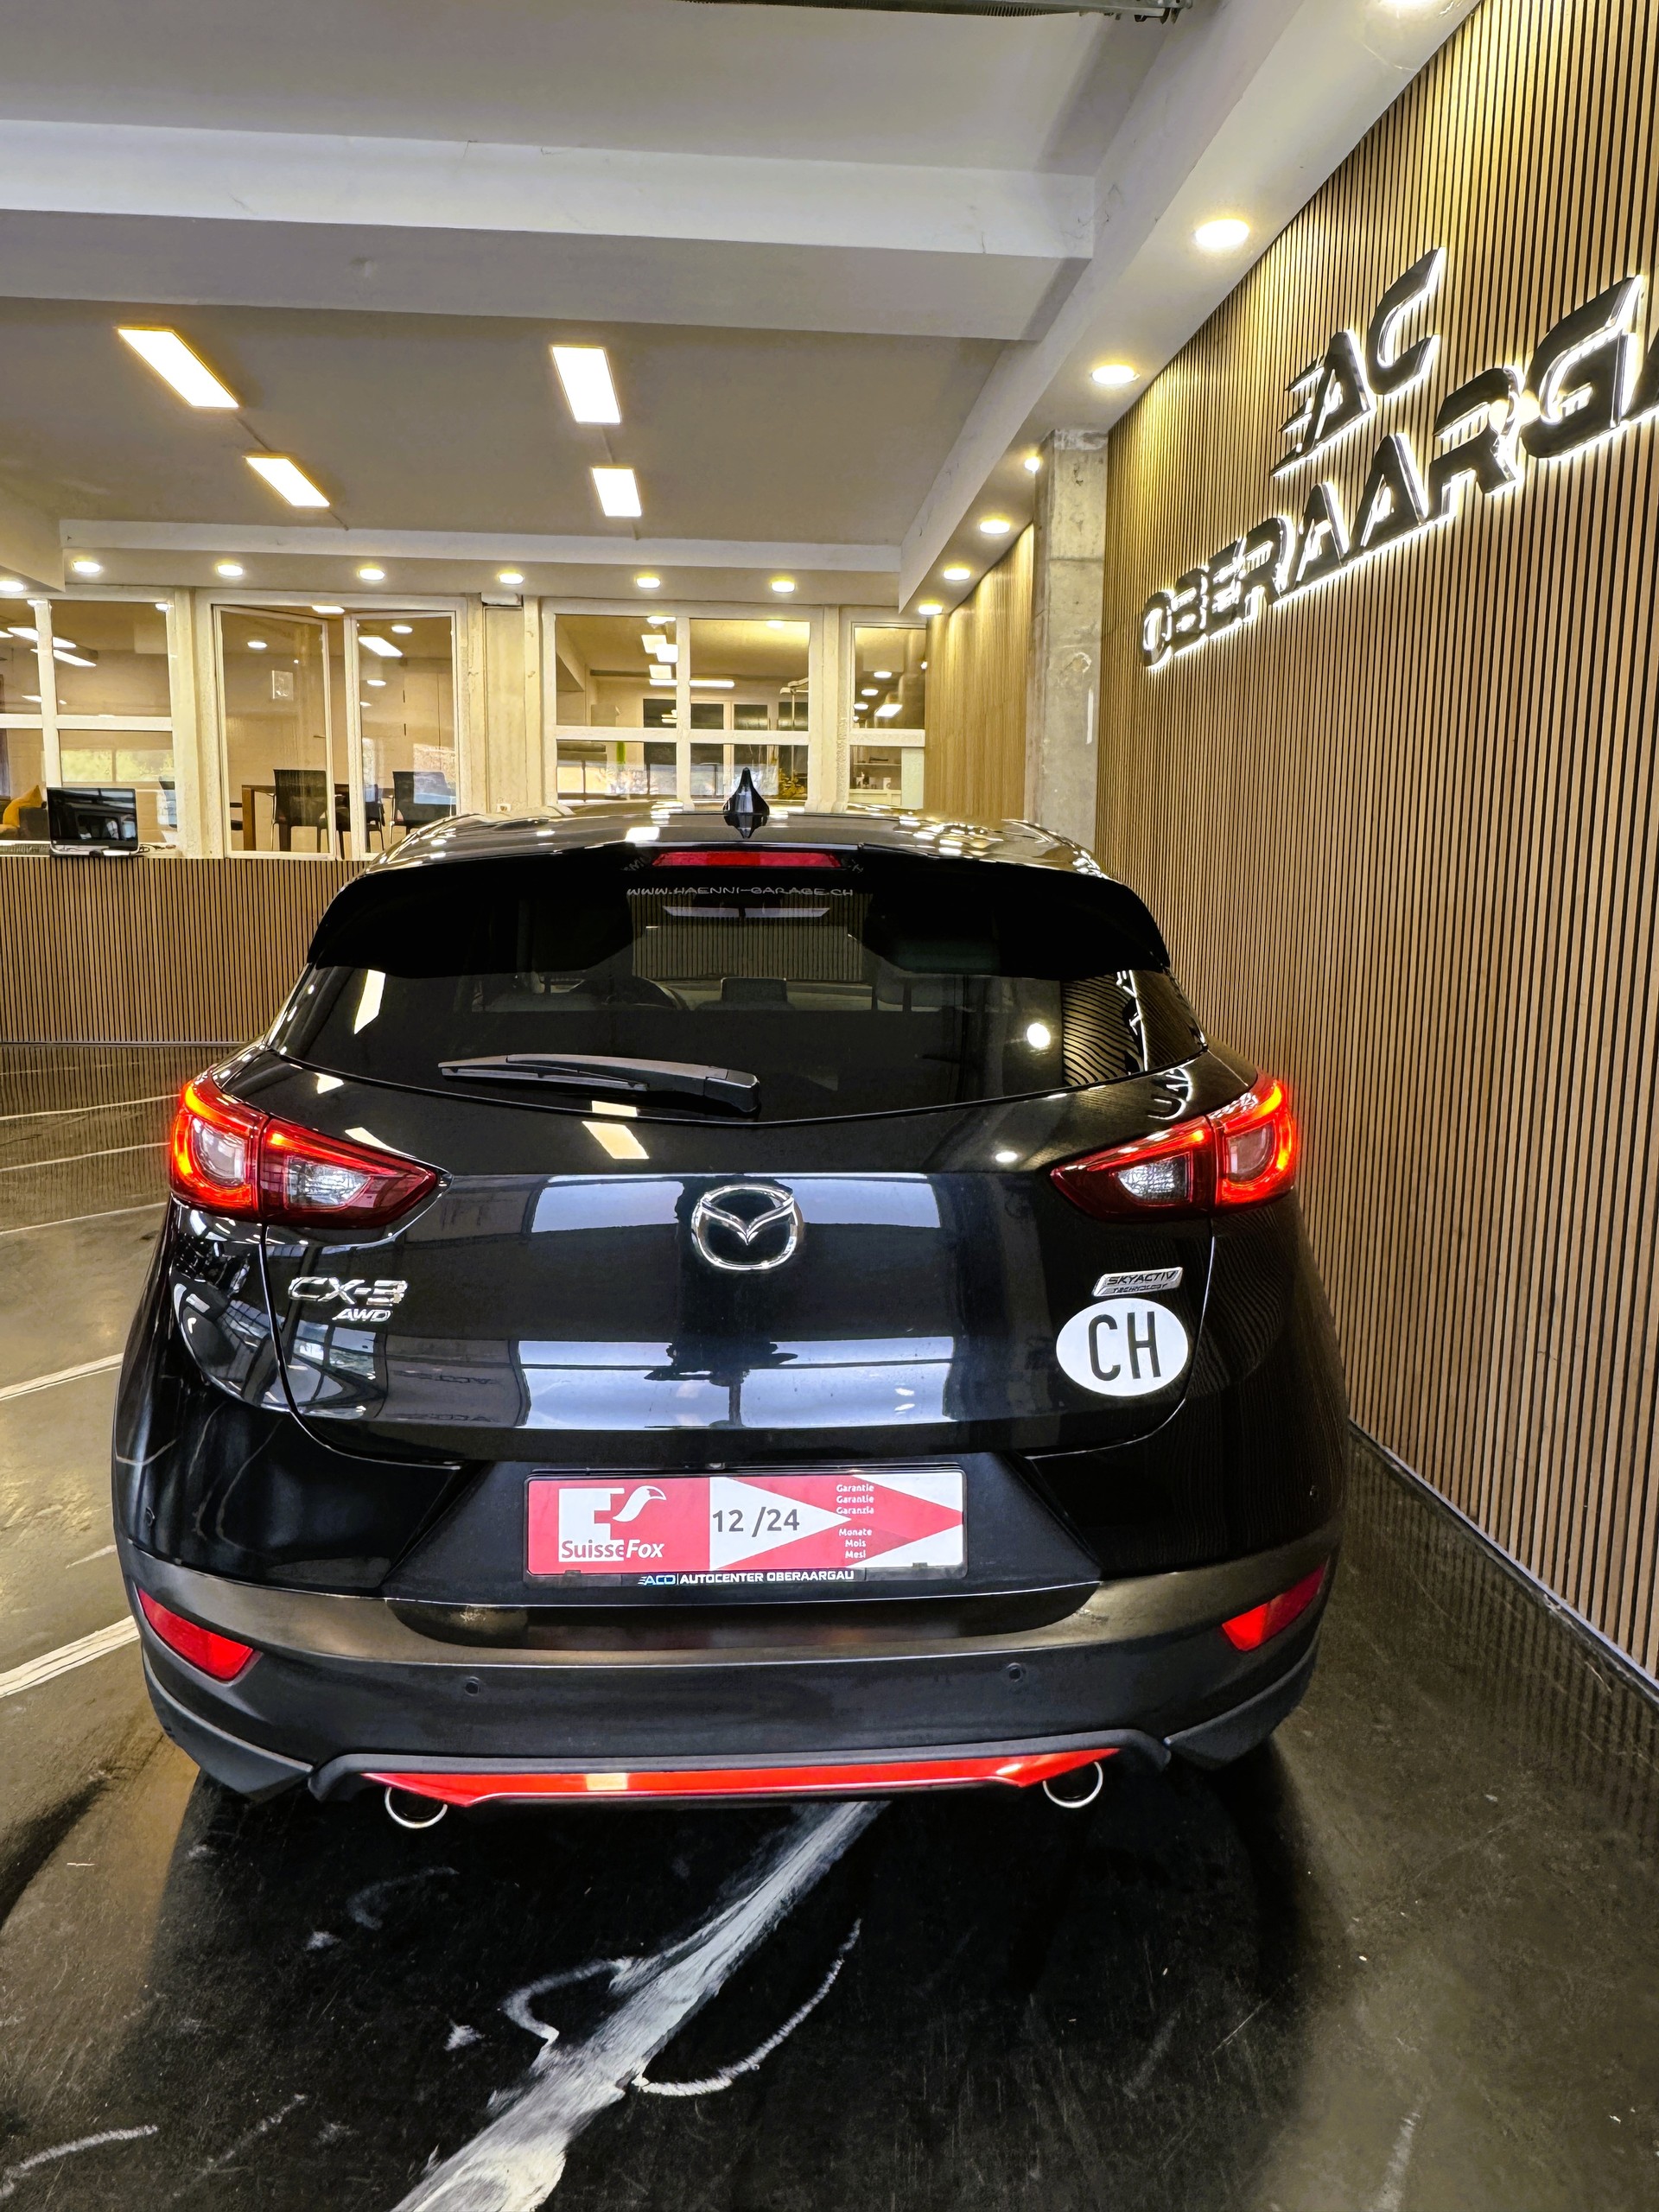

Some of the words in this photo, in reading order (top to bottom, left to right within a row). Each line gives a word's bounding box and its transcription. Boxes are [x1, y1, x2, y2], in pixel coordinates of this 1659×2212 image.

[1139, 275, 1659, 668] OBERAARG
[1107, 1270, 1176, 1286] SKYACTIV
[288, 1276, 408, 1306] CX-3
[332, 1308, 391, 1322] AWD
[1088, 1311, 1161, 1381] CH
[836, 1484, 874, 1492] Garantie
[836, 1495, 874, 1503] Garantie
[836, 1506, 874, 1515] Garanzia
[838, 1528, 873, 1536] Monate
[845, 1539, 866, 1548] Mois
[845, 1549, 866, 1559] Mesi
[680, 1573, 763, 1585] AUTOCENTER
[766, 1570, 855, 1582] OBERAARGAU
